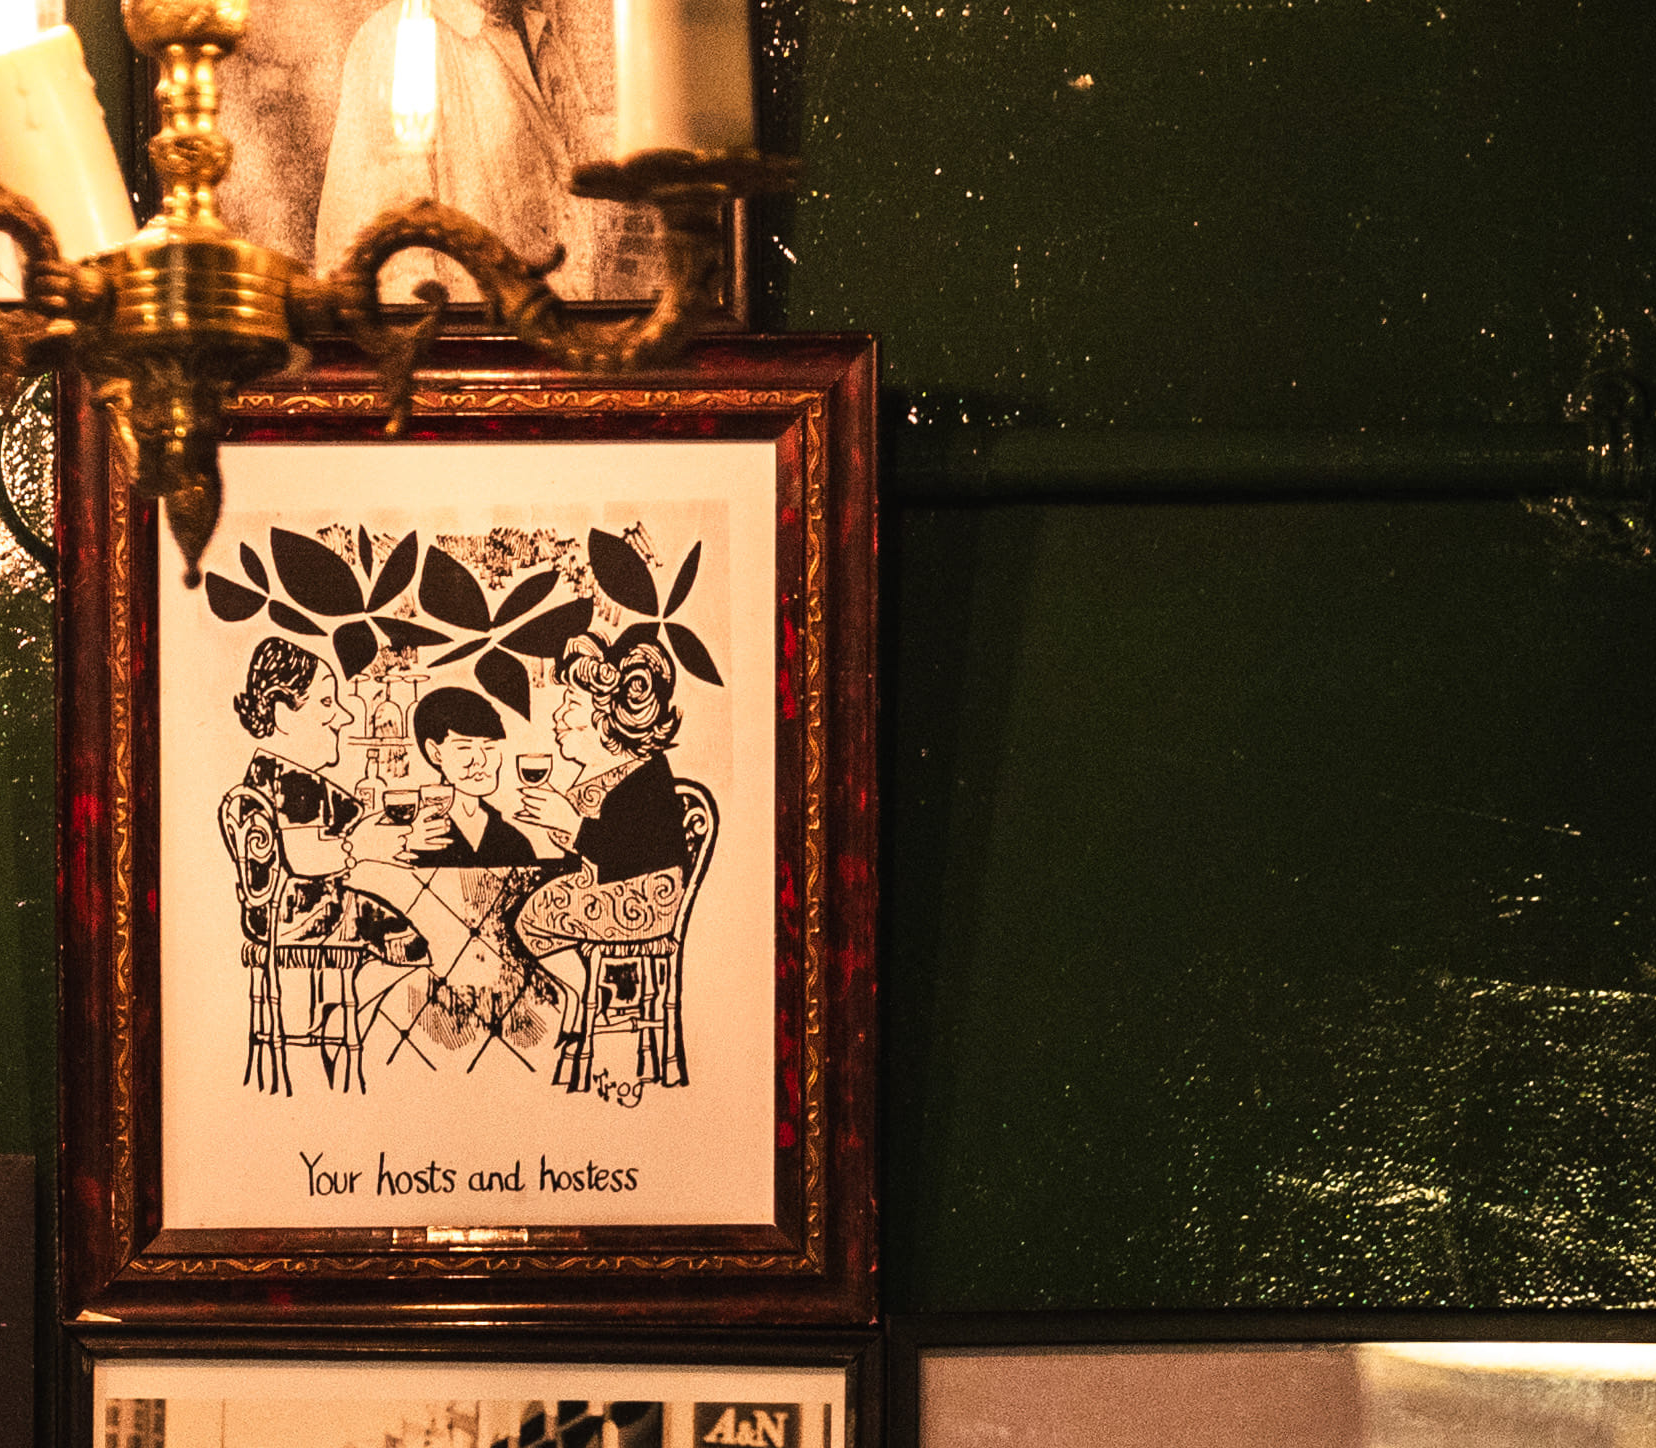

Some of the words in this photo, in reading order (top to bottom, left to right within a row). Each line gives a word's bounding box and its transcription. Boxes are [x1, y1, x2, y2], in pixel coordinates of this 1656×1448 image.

[593, 1068, 644, 1108] Trog
[299, 1151, 363, 1196] Your
[377, 1151, 457, 1196] hosts
[468, 1159, 526, 1192] and
[539, 1154, 639, 1193] hostess
